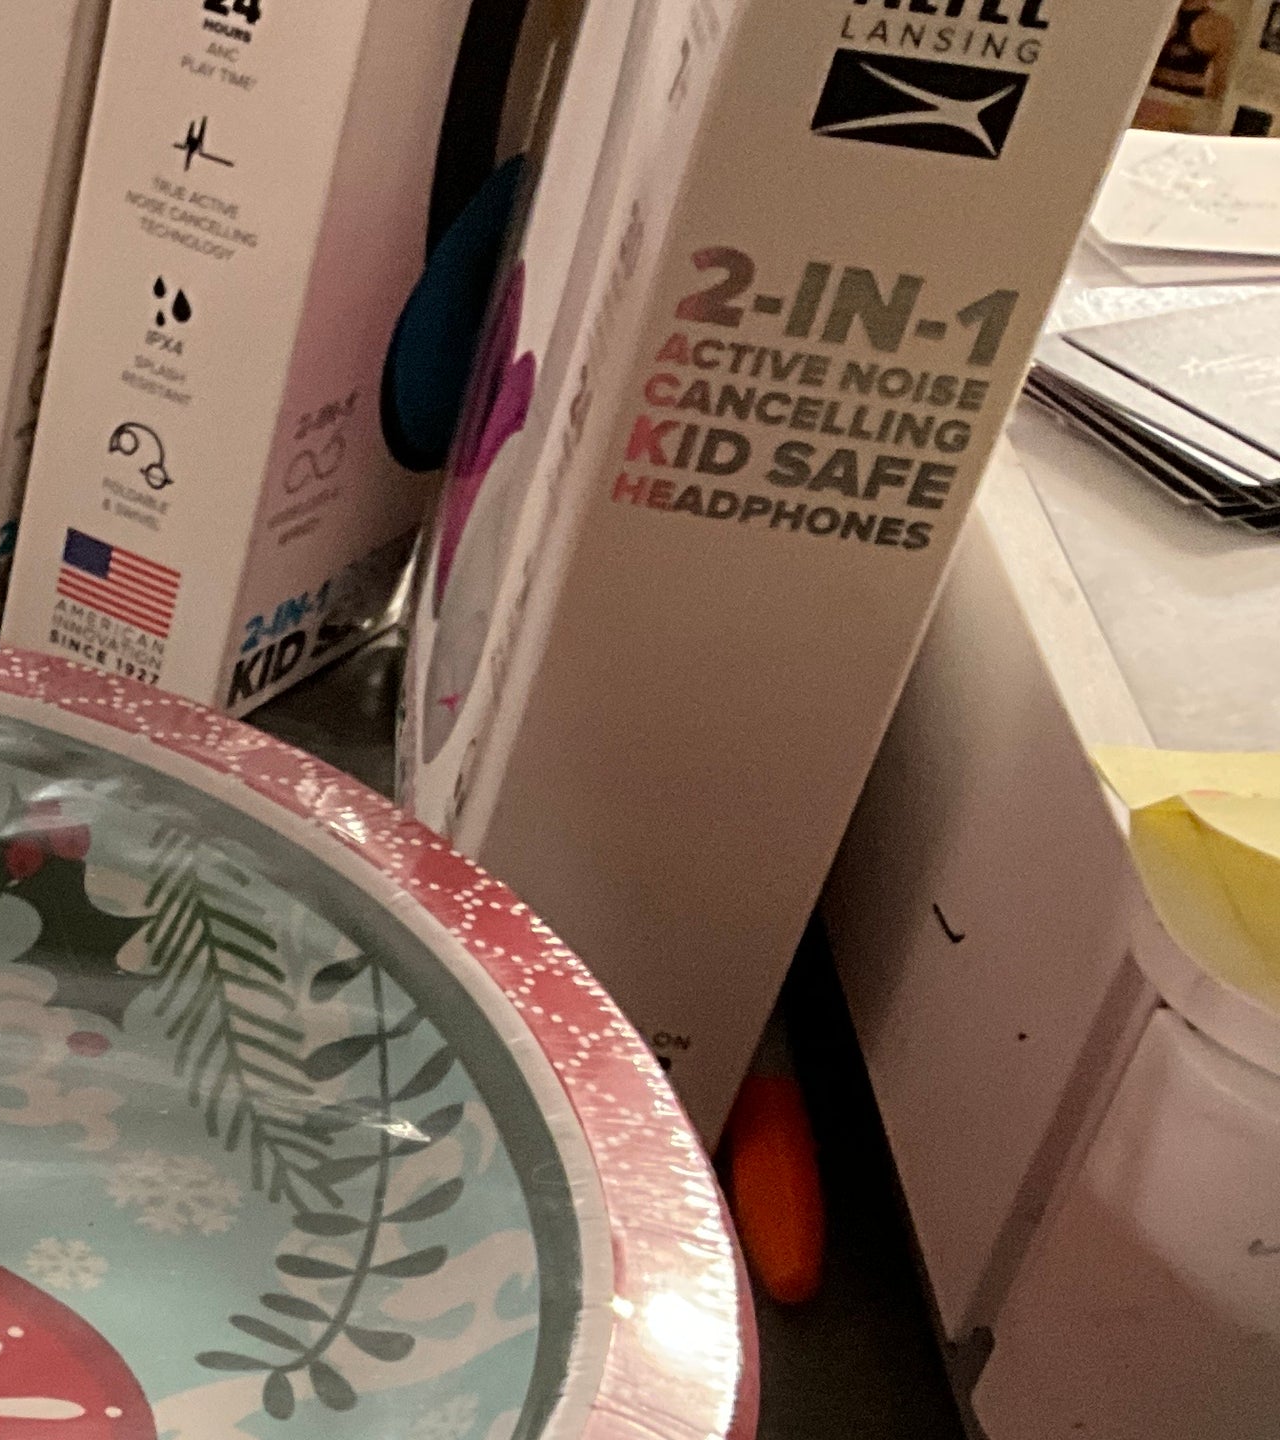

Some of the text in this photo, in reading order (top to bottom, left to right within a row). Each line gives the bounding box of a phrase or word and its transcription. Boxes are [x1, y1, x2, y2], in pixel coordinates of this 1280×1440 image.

[202, 17, 252, 44] HOURS
[840, 14, 1042, 65] LANSING
[125, 190, 258, 248] NOISE CANCELLING
[140, 216, 236, 261] TECHNOLOGY
[674, 246, 1020, 368] 2-IN-1
[655, 332, 991, 413] ACTIVE NOISE
[643, 372, 973, 454] CANCELLING
[623, 414, 958, 510] KID SAFE
[610, 472, 935, 551] HEADPHONES
[51, 613, 163, 671] INNOVATION
[54, 599, 166, 655] AMERICAN
[49, 628, 160, 686] SINCE 1927
[227, 630, 307, 708] KID
